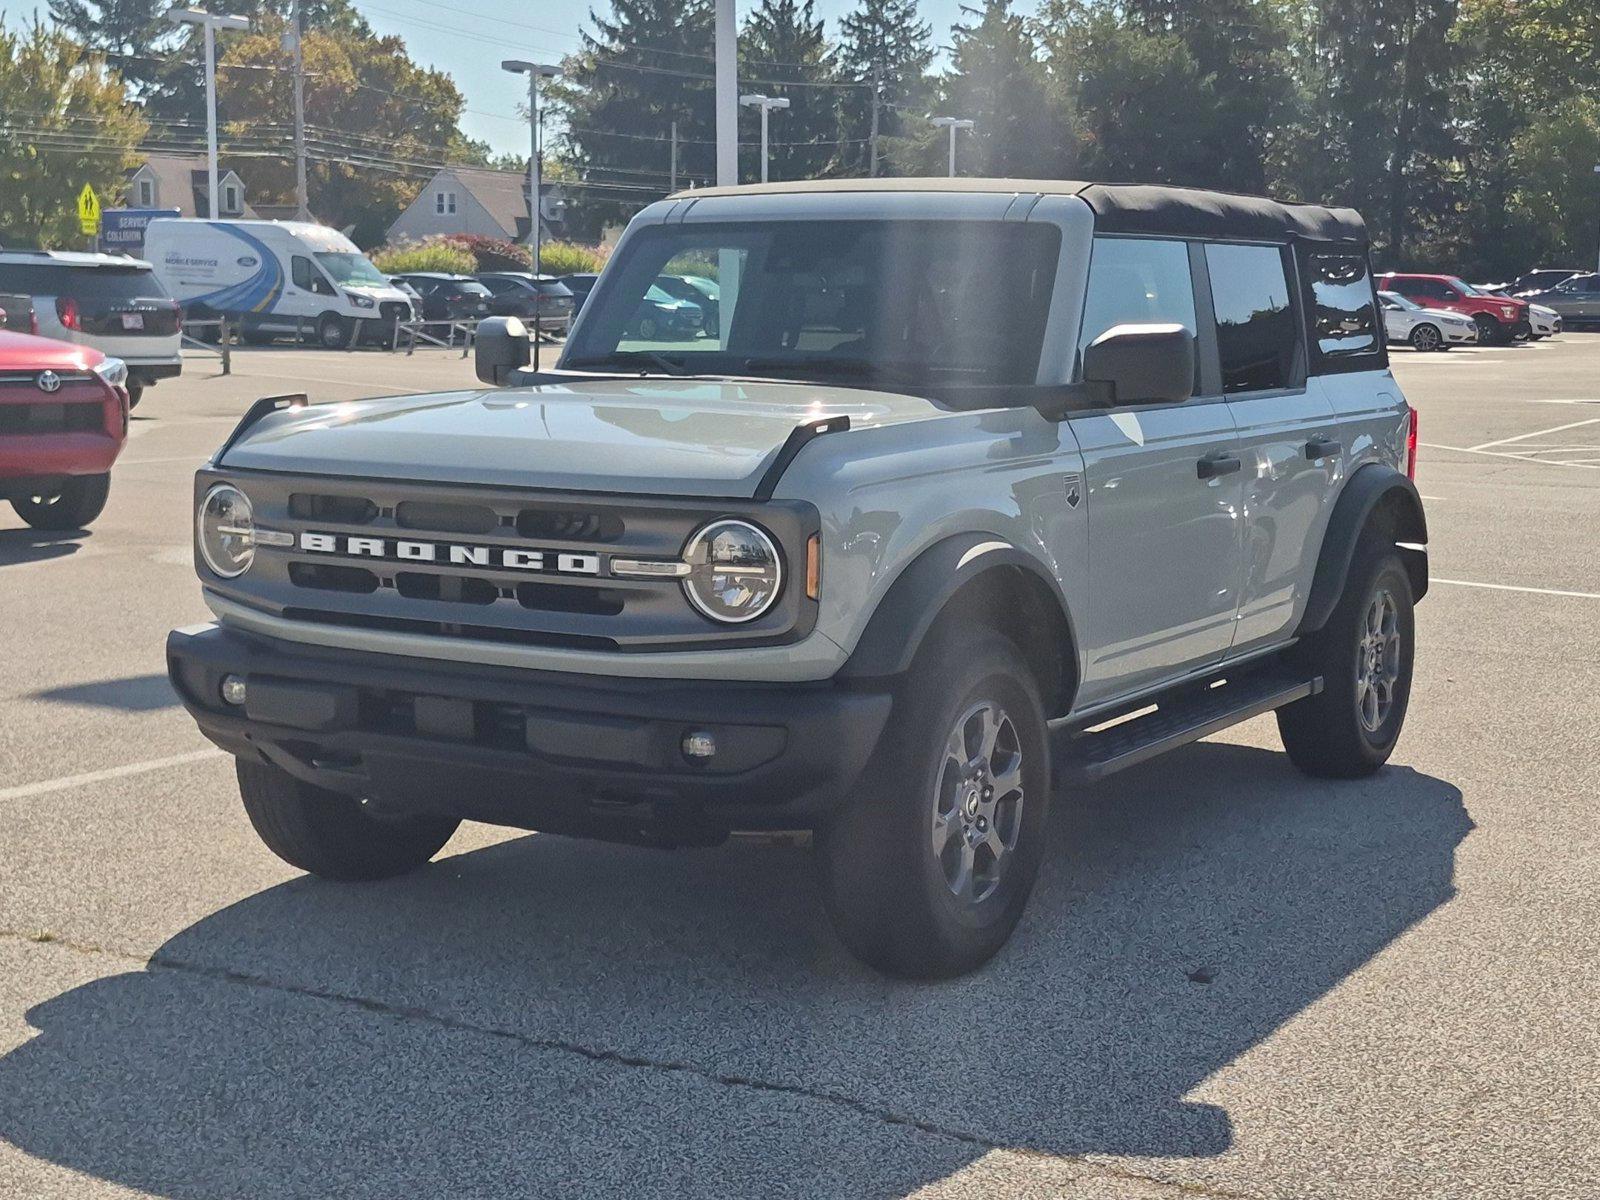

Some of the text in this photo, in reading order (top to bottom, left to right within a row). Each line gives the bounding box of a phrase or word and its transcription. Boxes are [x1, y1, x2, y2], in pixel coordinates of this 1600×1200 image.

[120, 216, 148, 229] SERVICE
[106, 230, 142, 242] COLLISION
[191, 258, 218, 267] SERVICE
[300, 532, 600, 574] BRONCO
